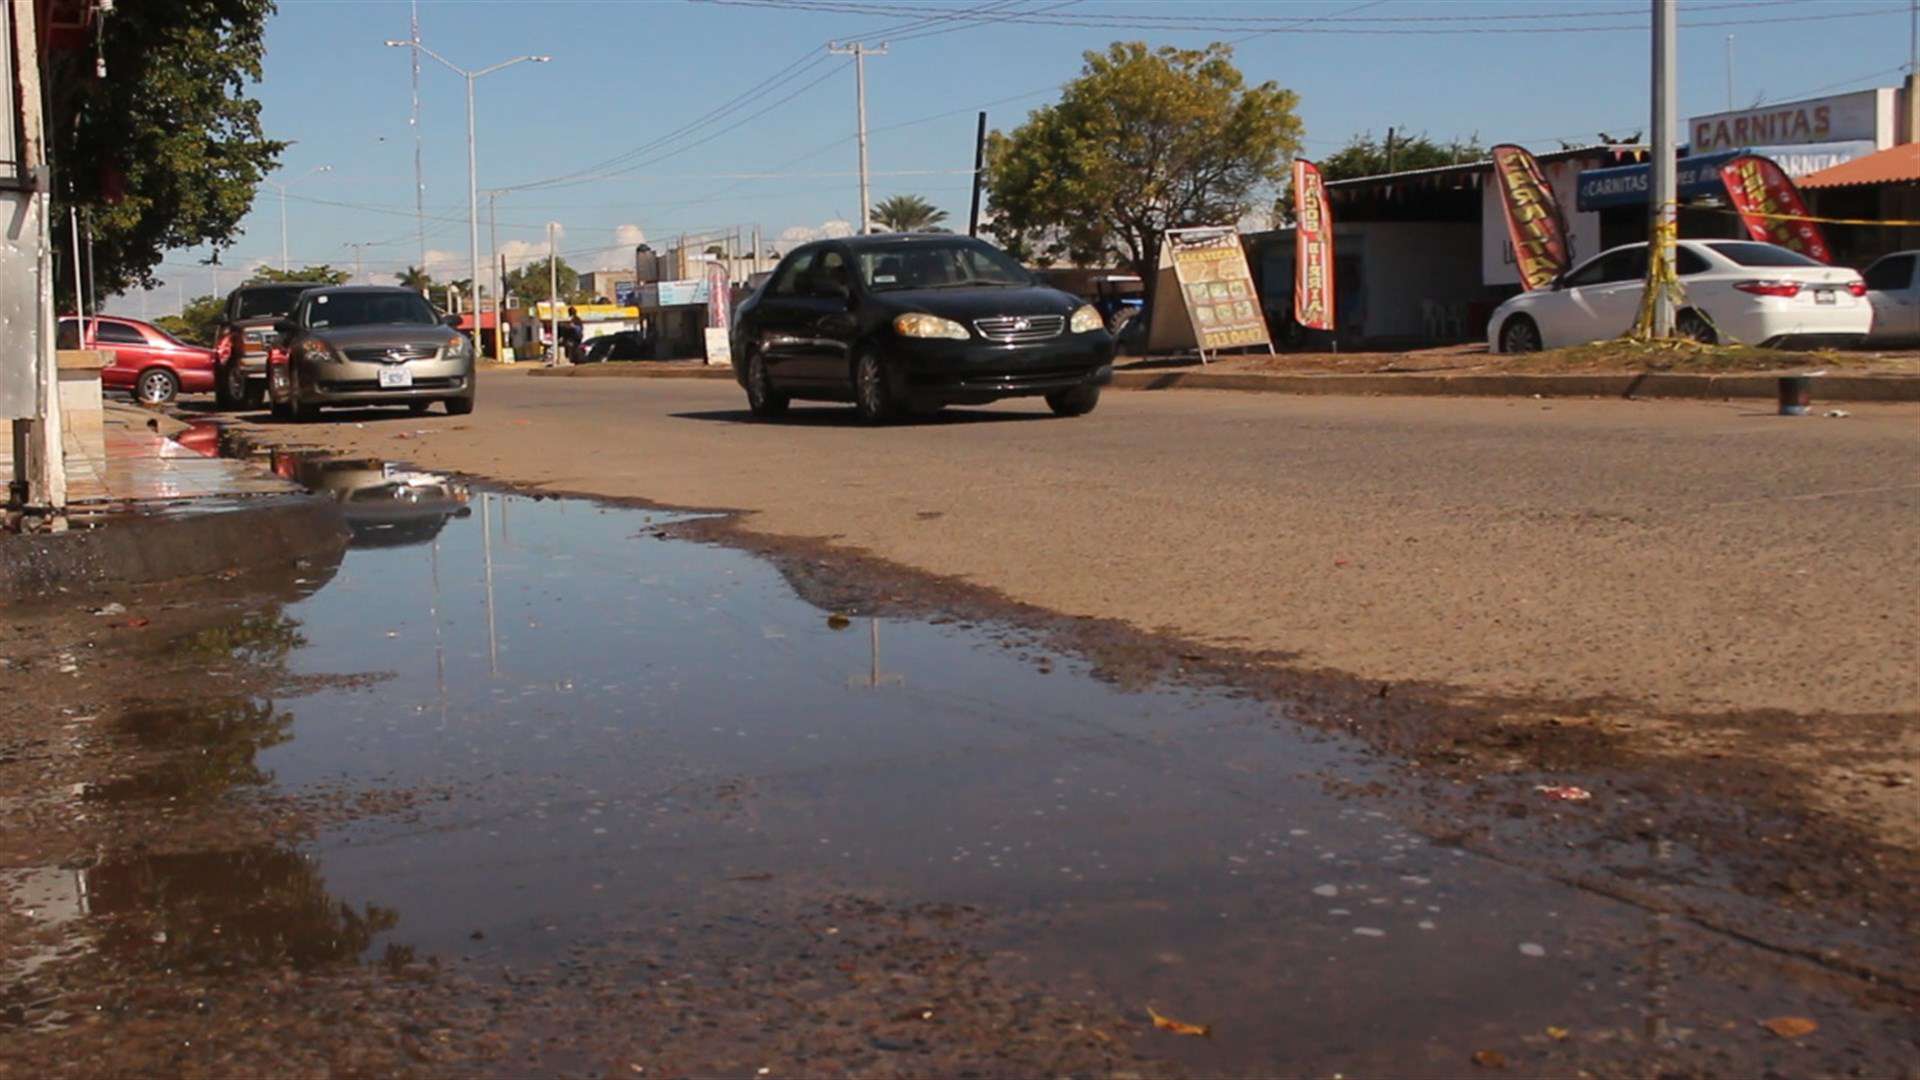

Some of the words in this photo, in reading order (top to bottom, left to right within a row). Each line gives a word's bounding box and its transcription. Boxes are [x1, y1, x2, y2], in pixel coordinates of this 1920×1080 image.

[1696, 105, 1831, 152] CARNITAS
[1587, 173, 1648, 197] CARNITAS
[1768, 154, 1851, 178] ARNITA
[1305, 173, 1320, 232] TACOS
[1308, 241, 1323, 313] BIRRIA
